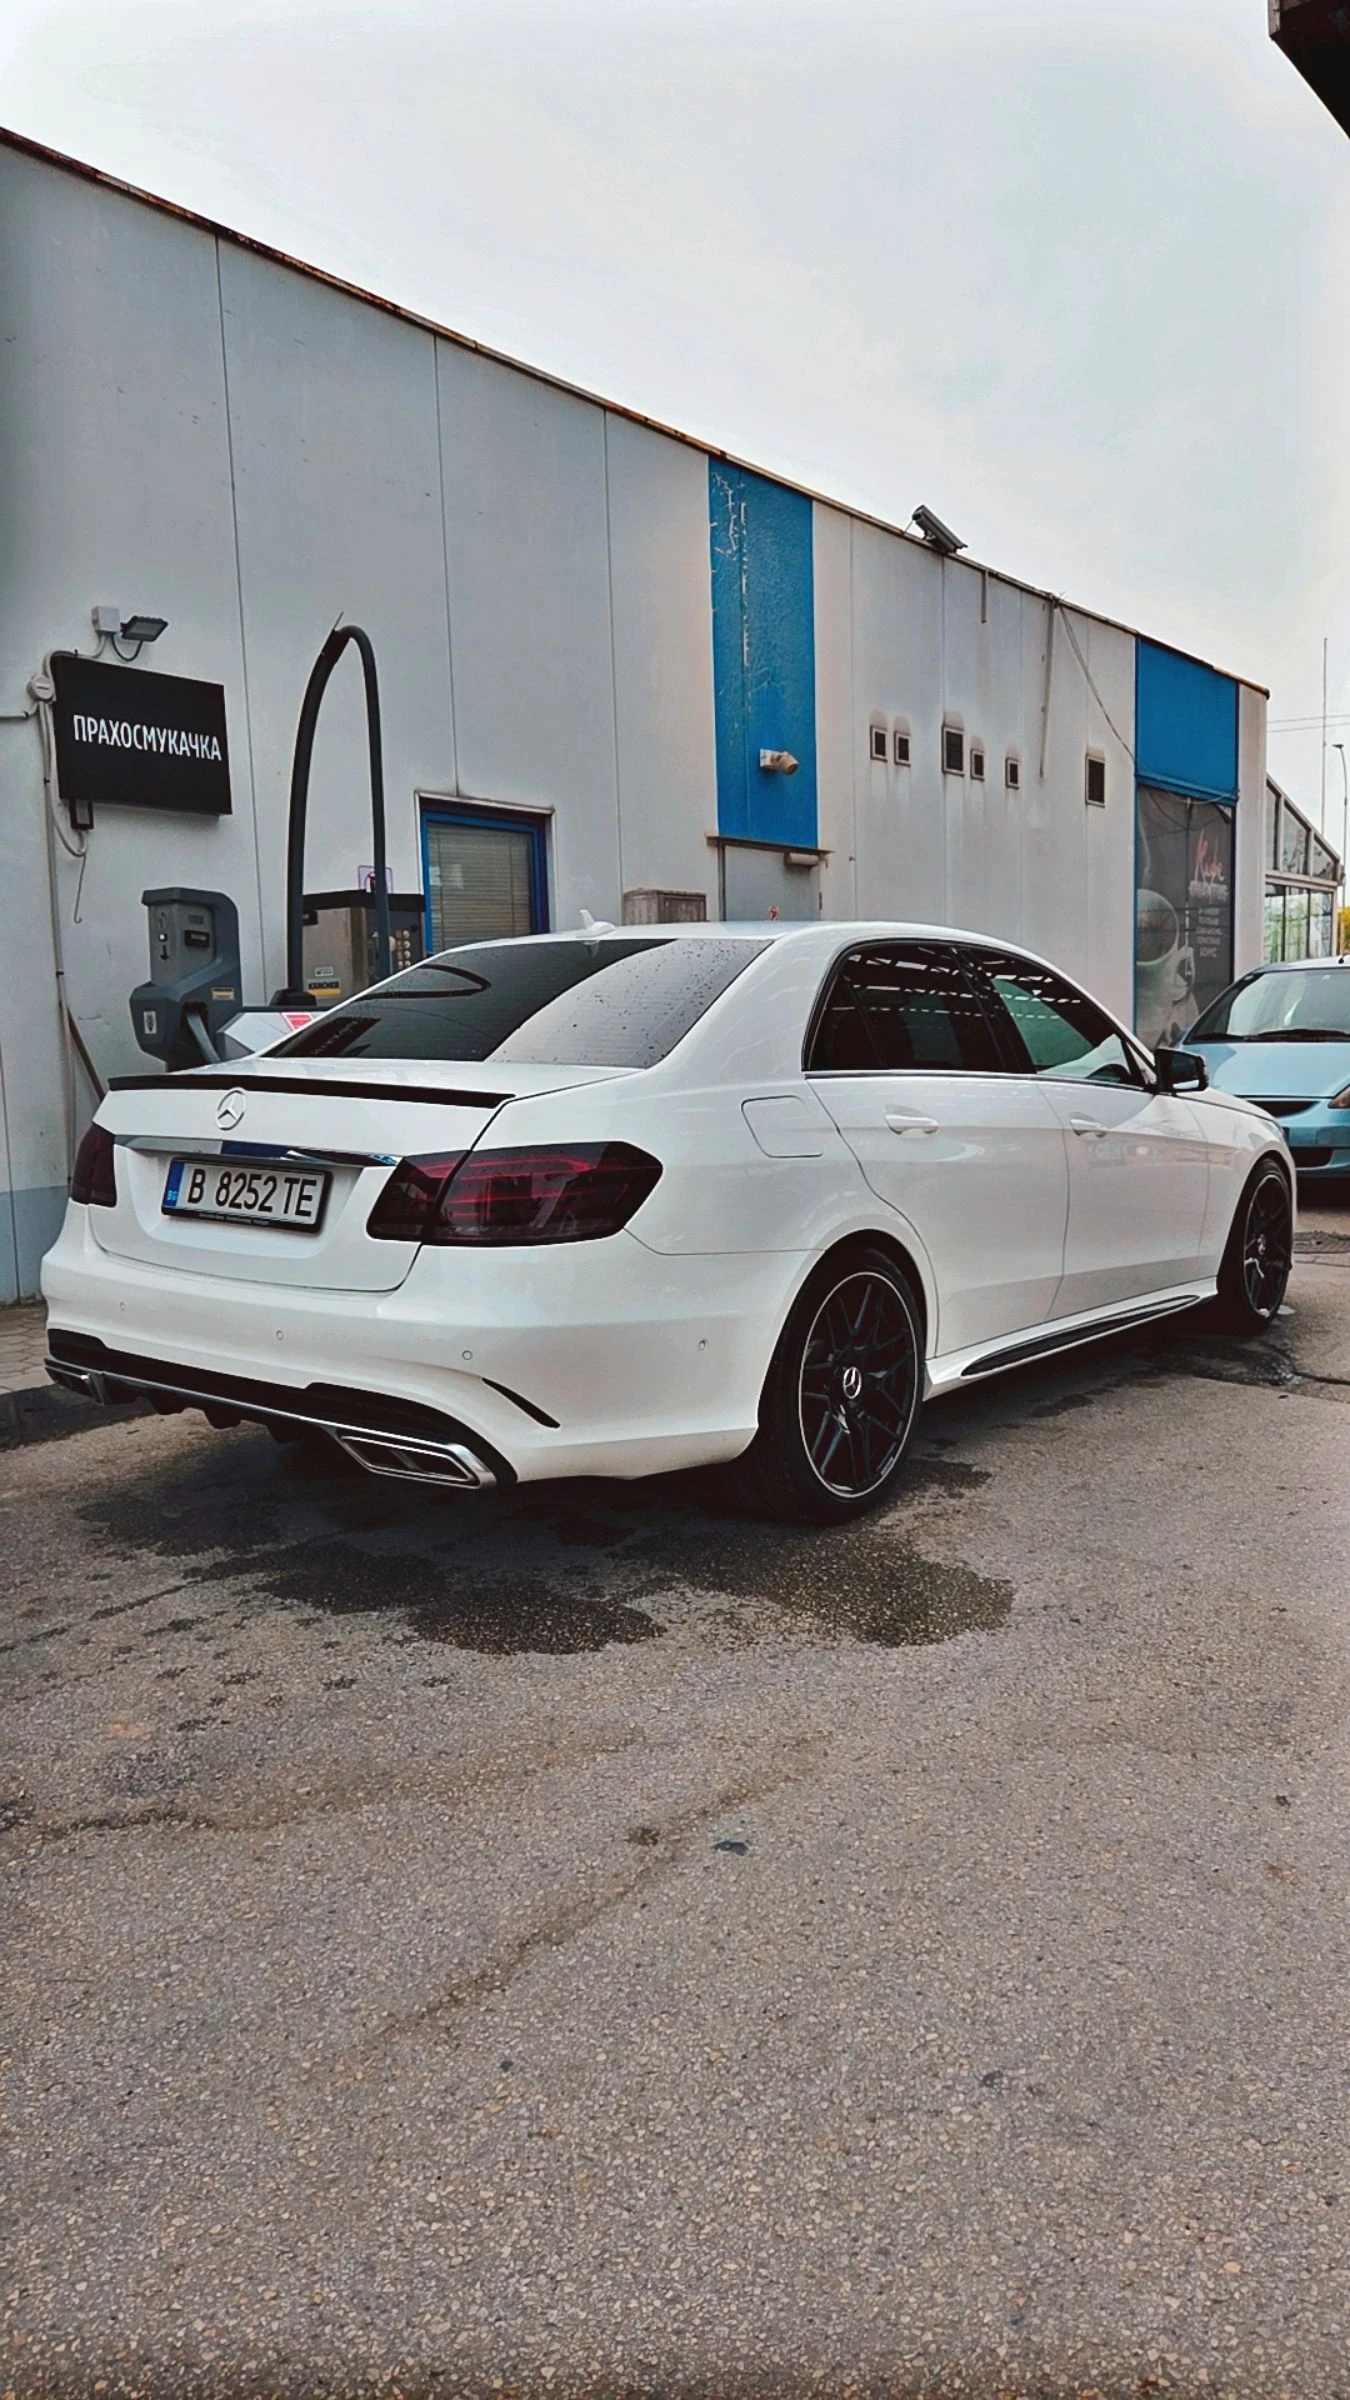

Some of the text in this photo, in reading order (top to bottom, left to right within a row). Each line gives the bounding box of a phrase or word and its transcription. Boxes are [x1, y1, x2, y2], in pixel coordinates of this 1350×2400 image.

[73, 714, 222, 761] ПРАХОСМУКАЧКА
[187, 1168, 317, 1217] B 8252 TE
